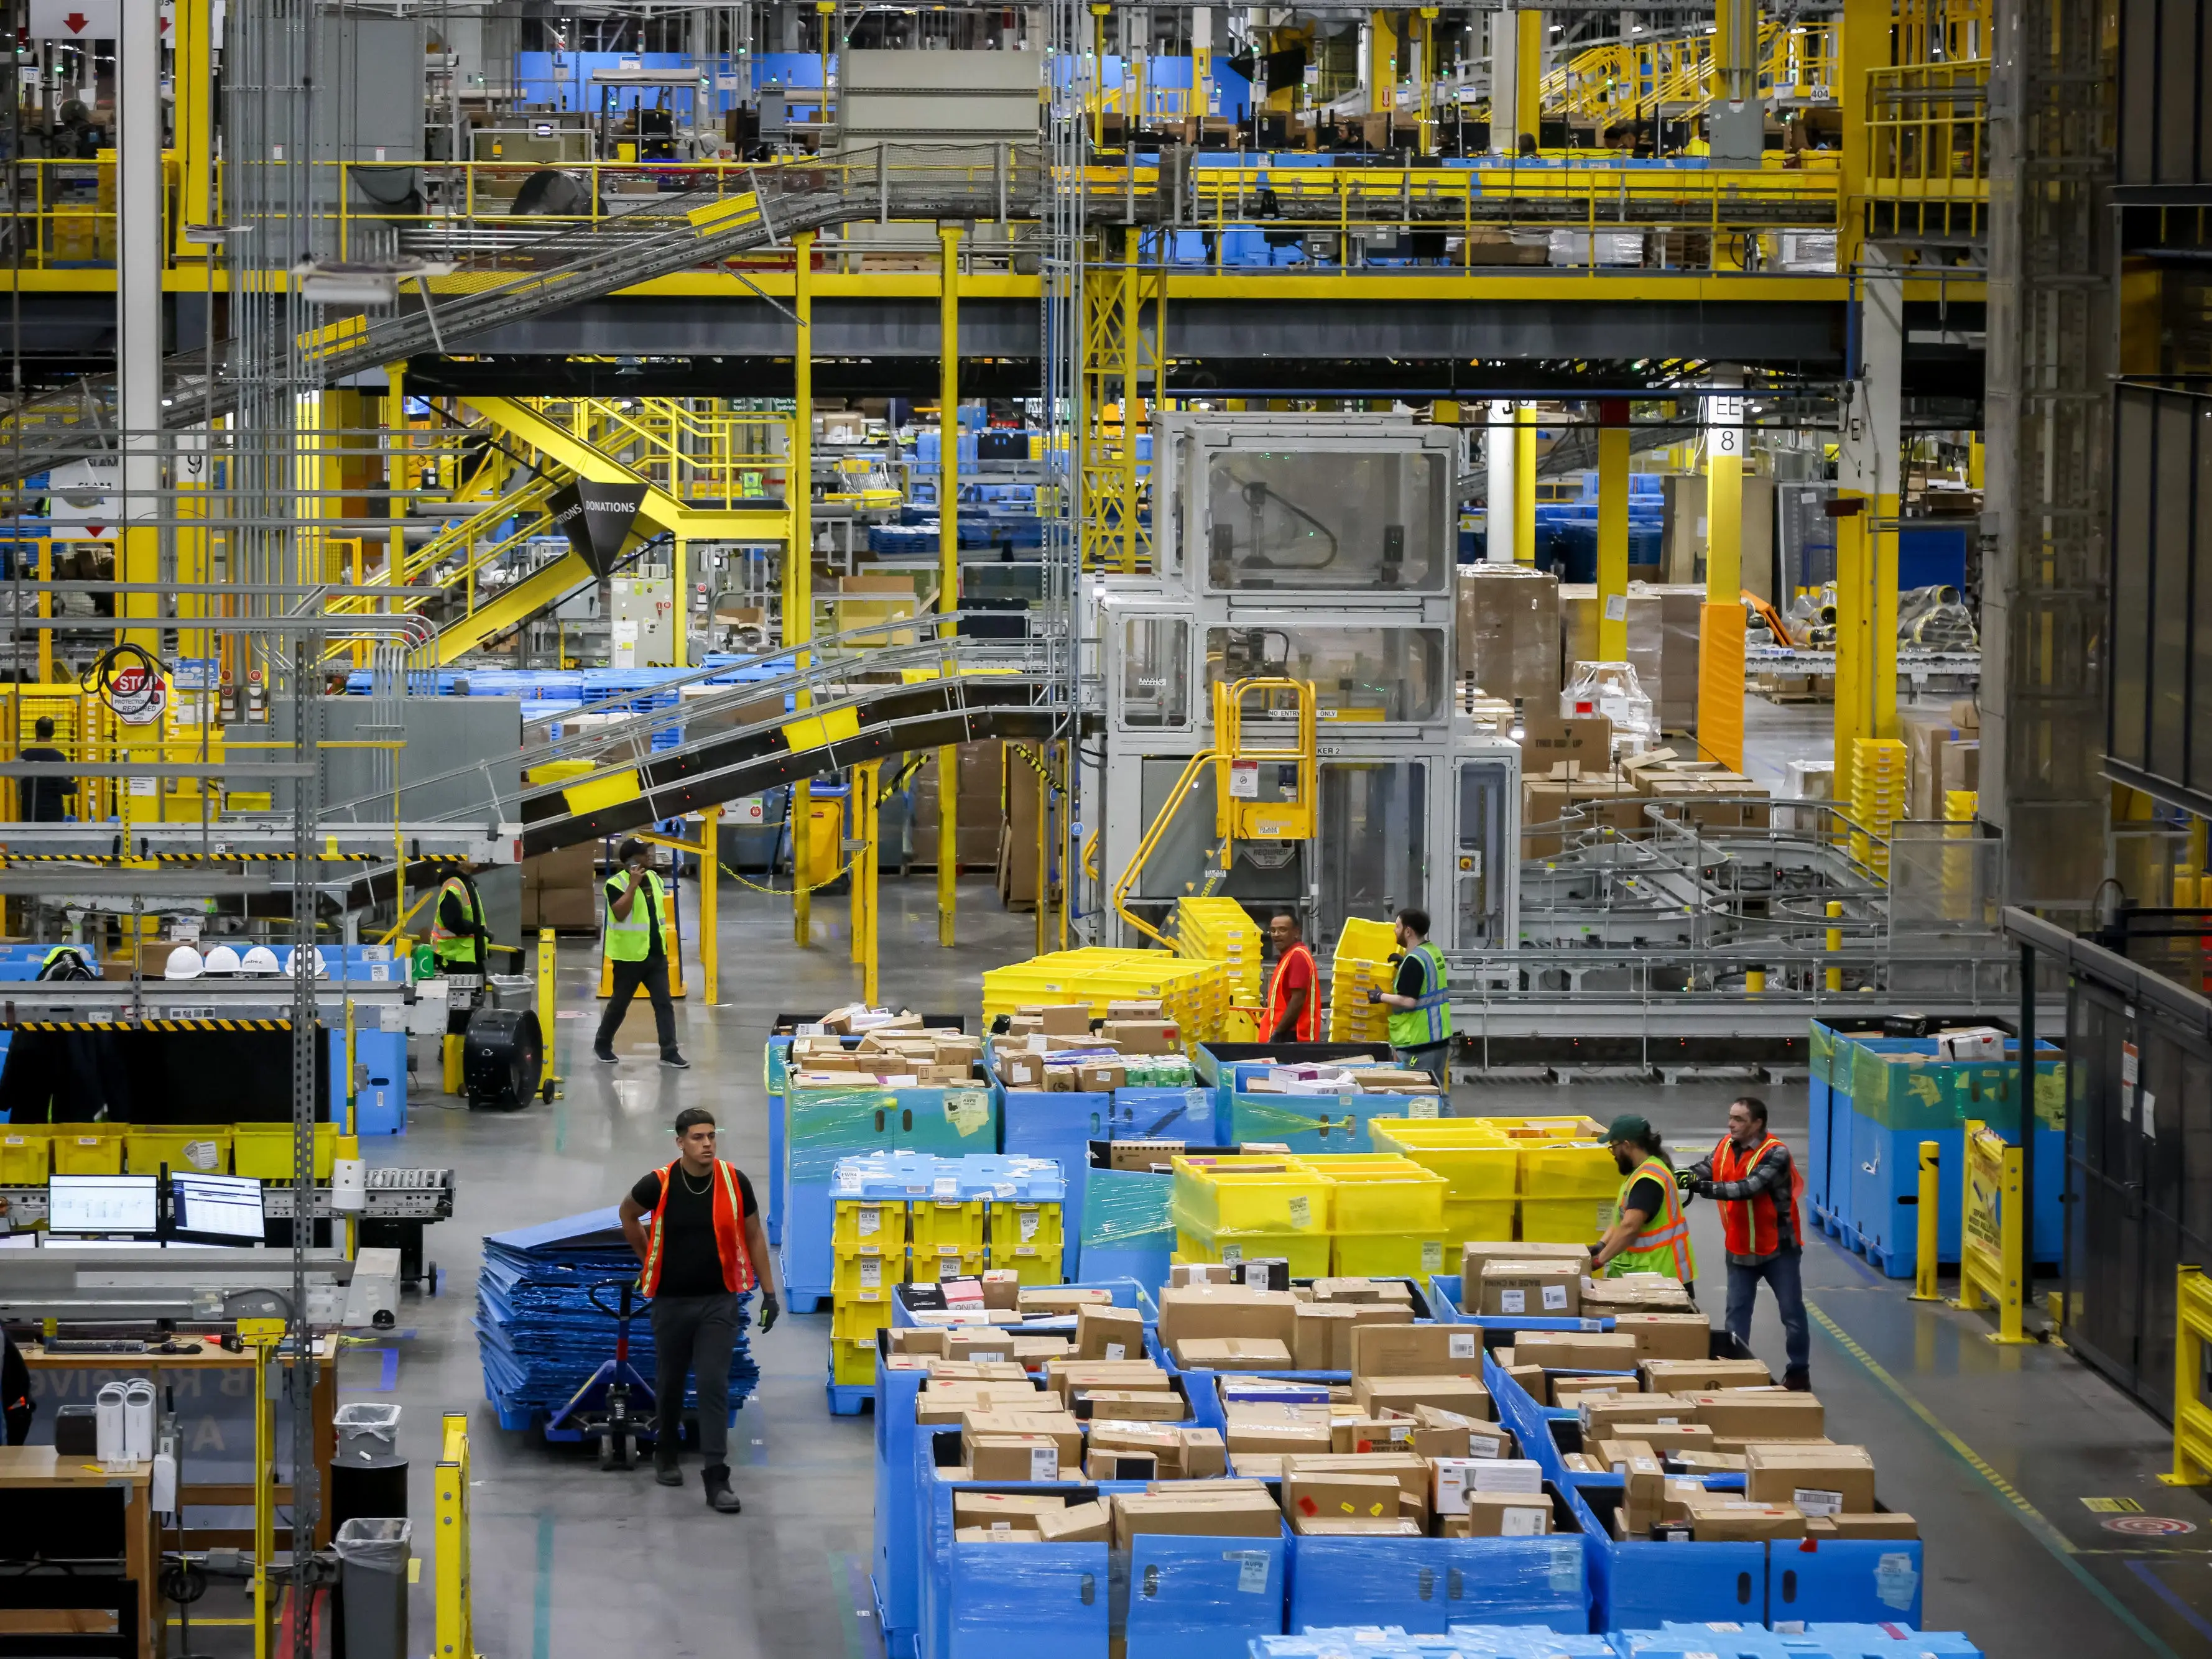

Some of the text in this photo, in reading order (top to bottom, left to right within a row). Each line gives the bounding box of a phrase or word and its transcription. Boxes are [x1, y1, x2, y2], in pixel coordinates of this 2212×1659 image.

[1811, 90, 1828, 98] 404
[1721, 430, 1734, 451] 8
[586, 500, 636, 513] DONATIONS
[119, 675, 158, 691] STOP
